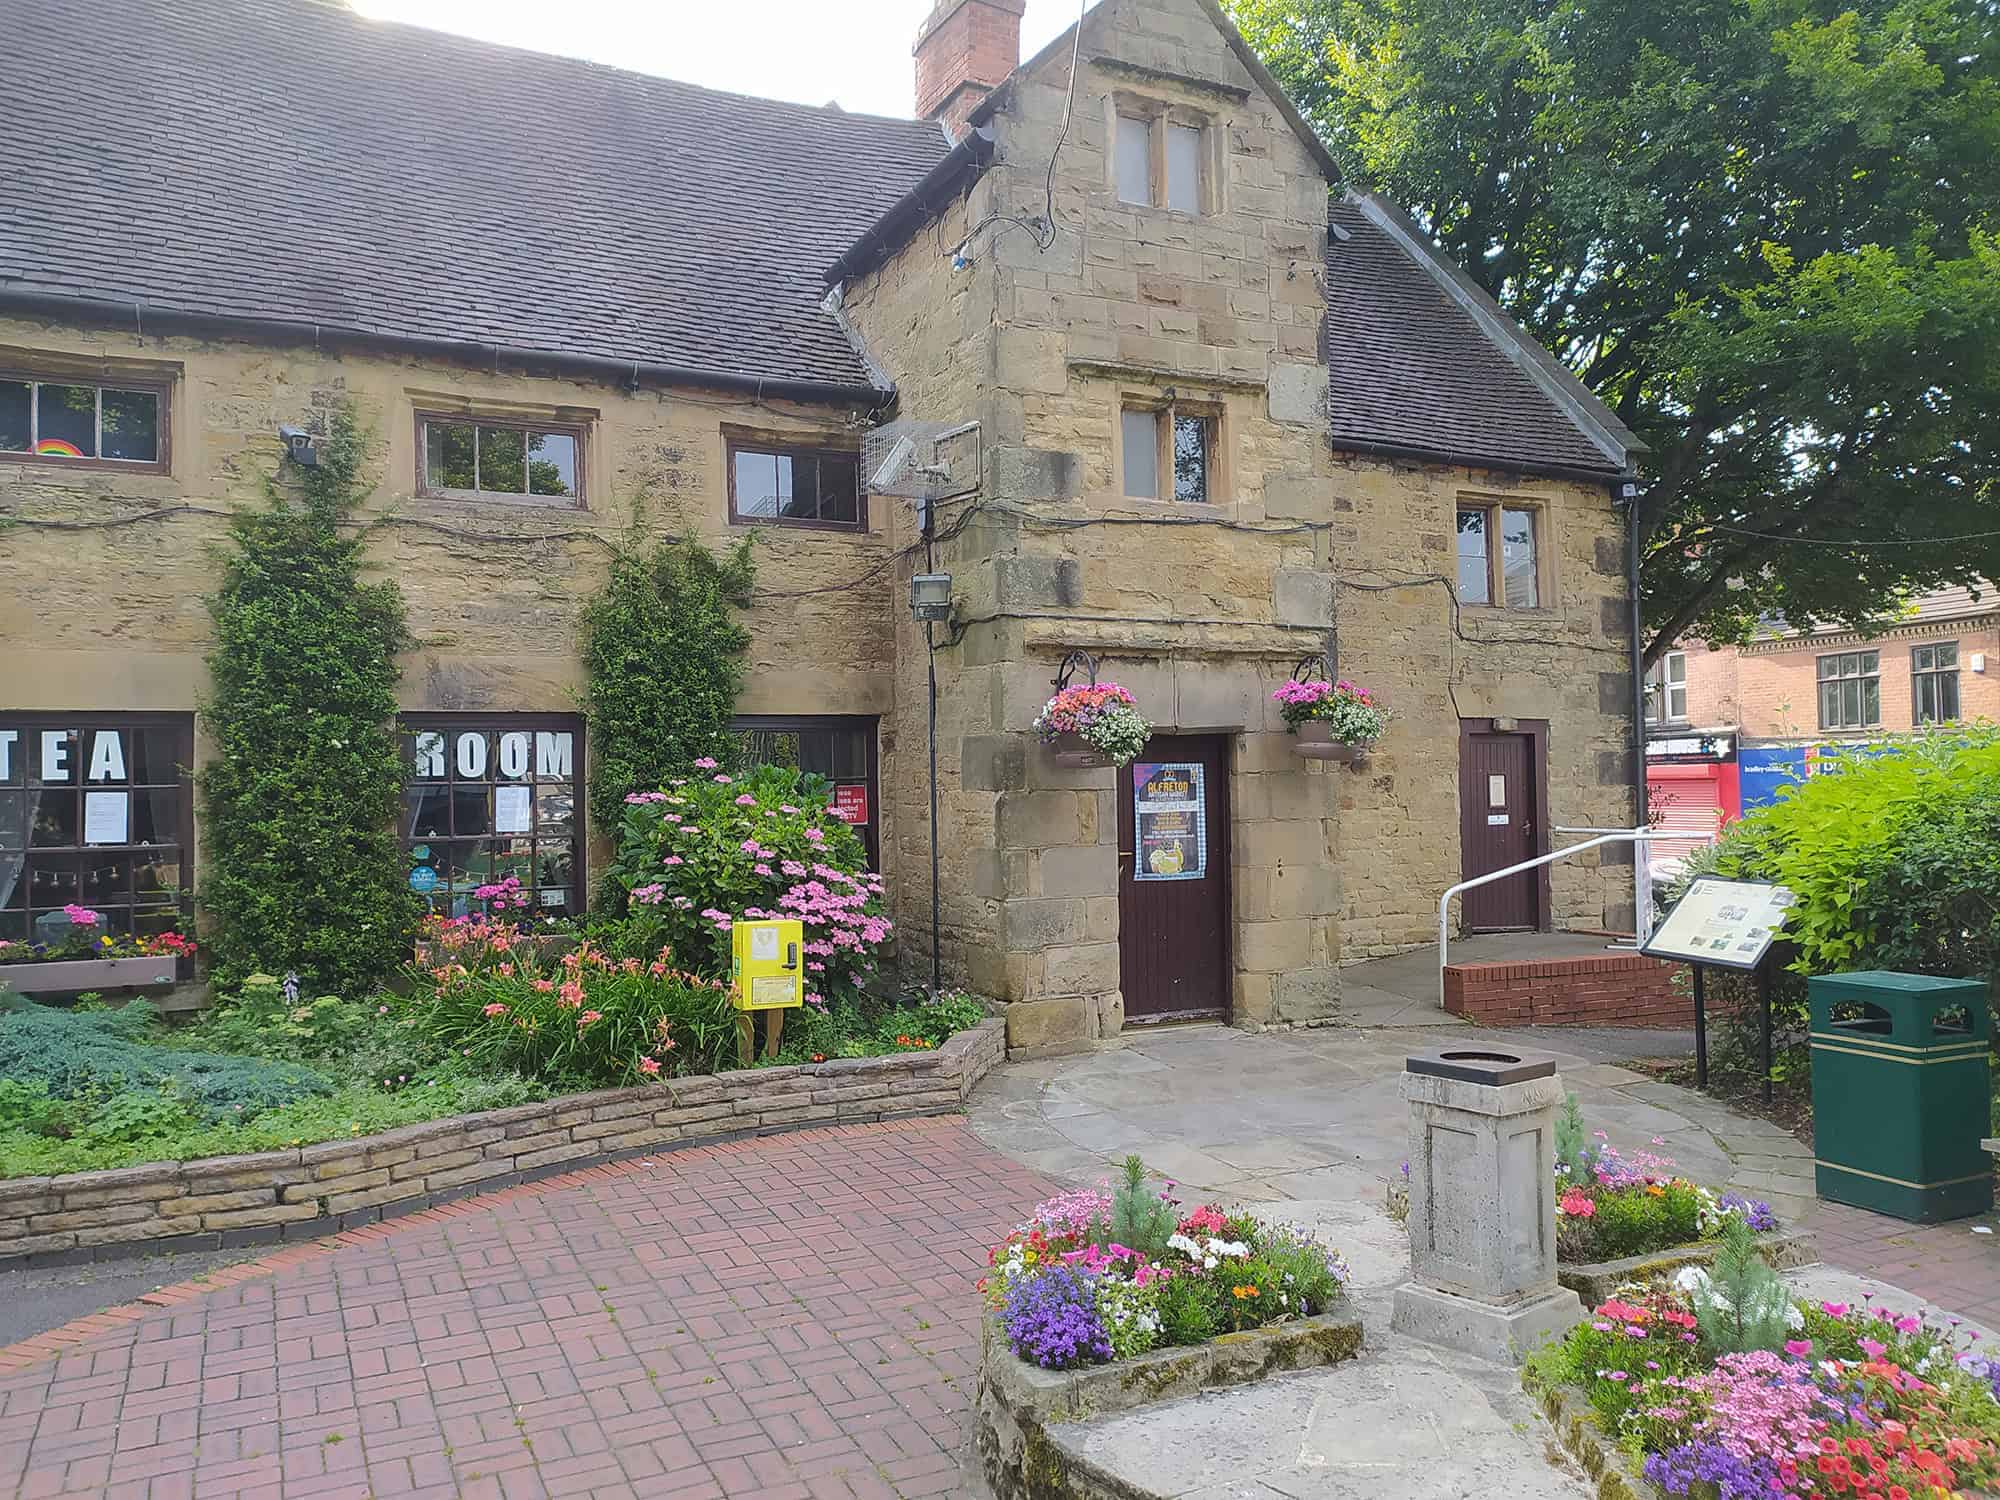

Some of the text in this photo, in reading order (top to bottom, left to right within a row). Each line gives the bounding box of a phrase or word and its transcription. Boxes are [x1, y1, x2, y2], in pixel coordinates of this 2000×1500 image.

[0, 730, 574, 781] TEA ROOM
[1147, 781, 1189, 793] ALFRETON
